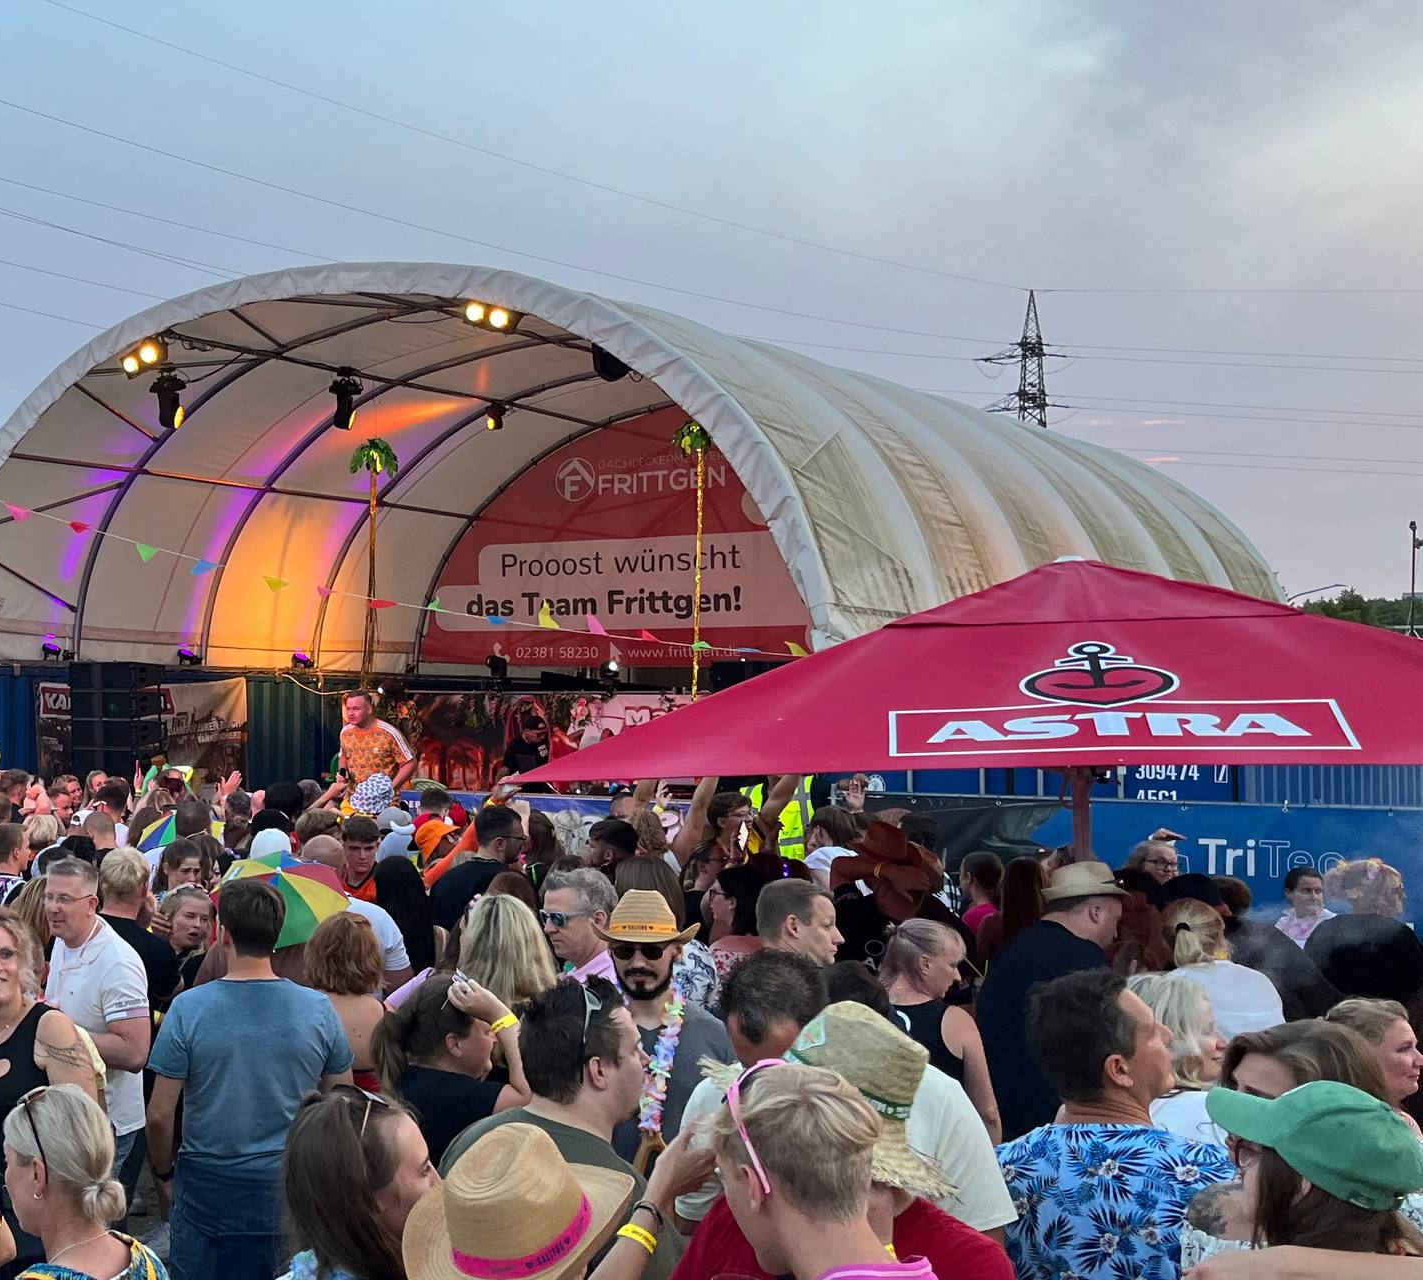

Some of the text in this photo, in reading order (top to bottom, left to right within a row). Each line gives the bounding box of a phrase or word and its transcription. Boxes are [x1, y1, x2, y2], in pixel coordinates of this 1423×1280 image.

[598, 465, 725, 496] FRITTGEN
[501, 544, 742, 578] Prooost wünscht
[466, 585, 742, 620] das Team Frittgen!
[515, 646, 599, 659] 02381 58230
[926, 711, 1313, 744] ASTRA
